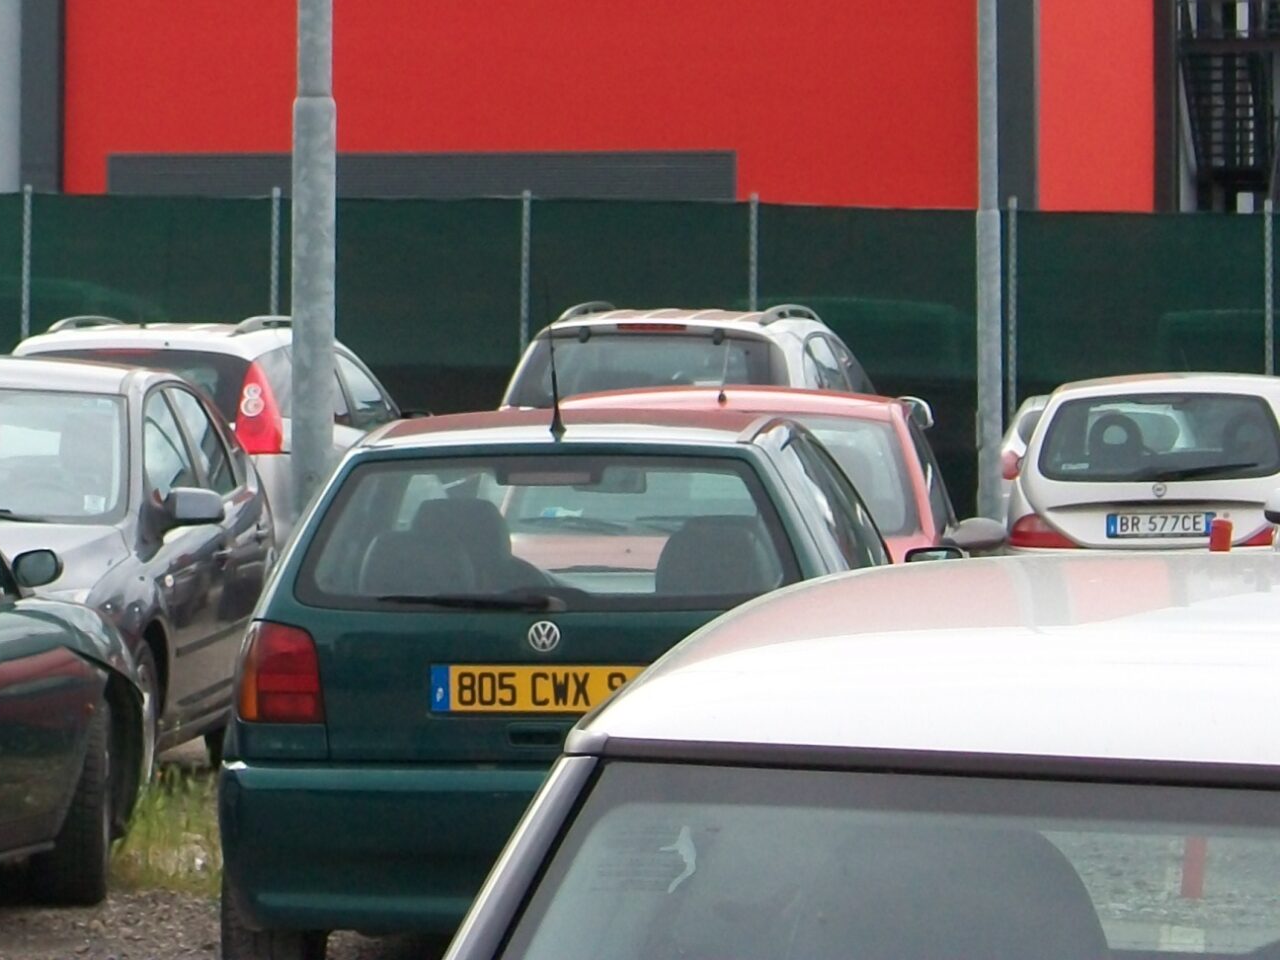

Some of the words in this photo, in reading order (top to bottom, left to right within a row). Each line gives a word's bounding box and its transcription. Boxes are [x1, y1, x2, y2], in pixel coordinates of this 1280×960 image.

[1120, 516, 1140, 532] BR
[1148, 515, 1202, 532] 577CE
[457, 672, 517, 706] 805
[531, 672, 591, 706] CWX
